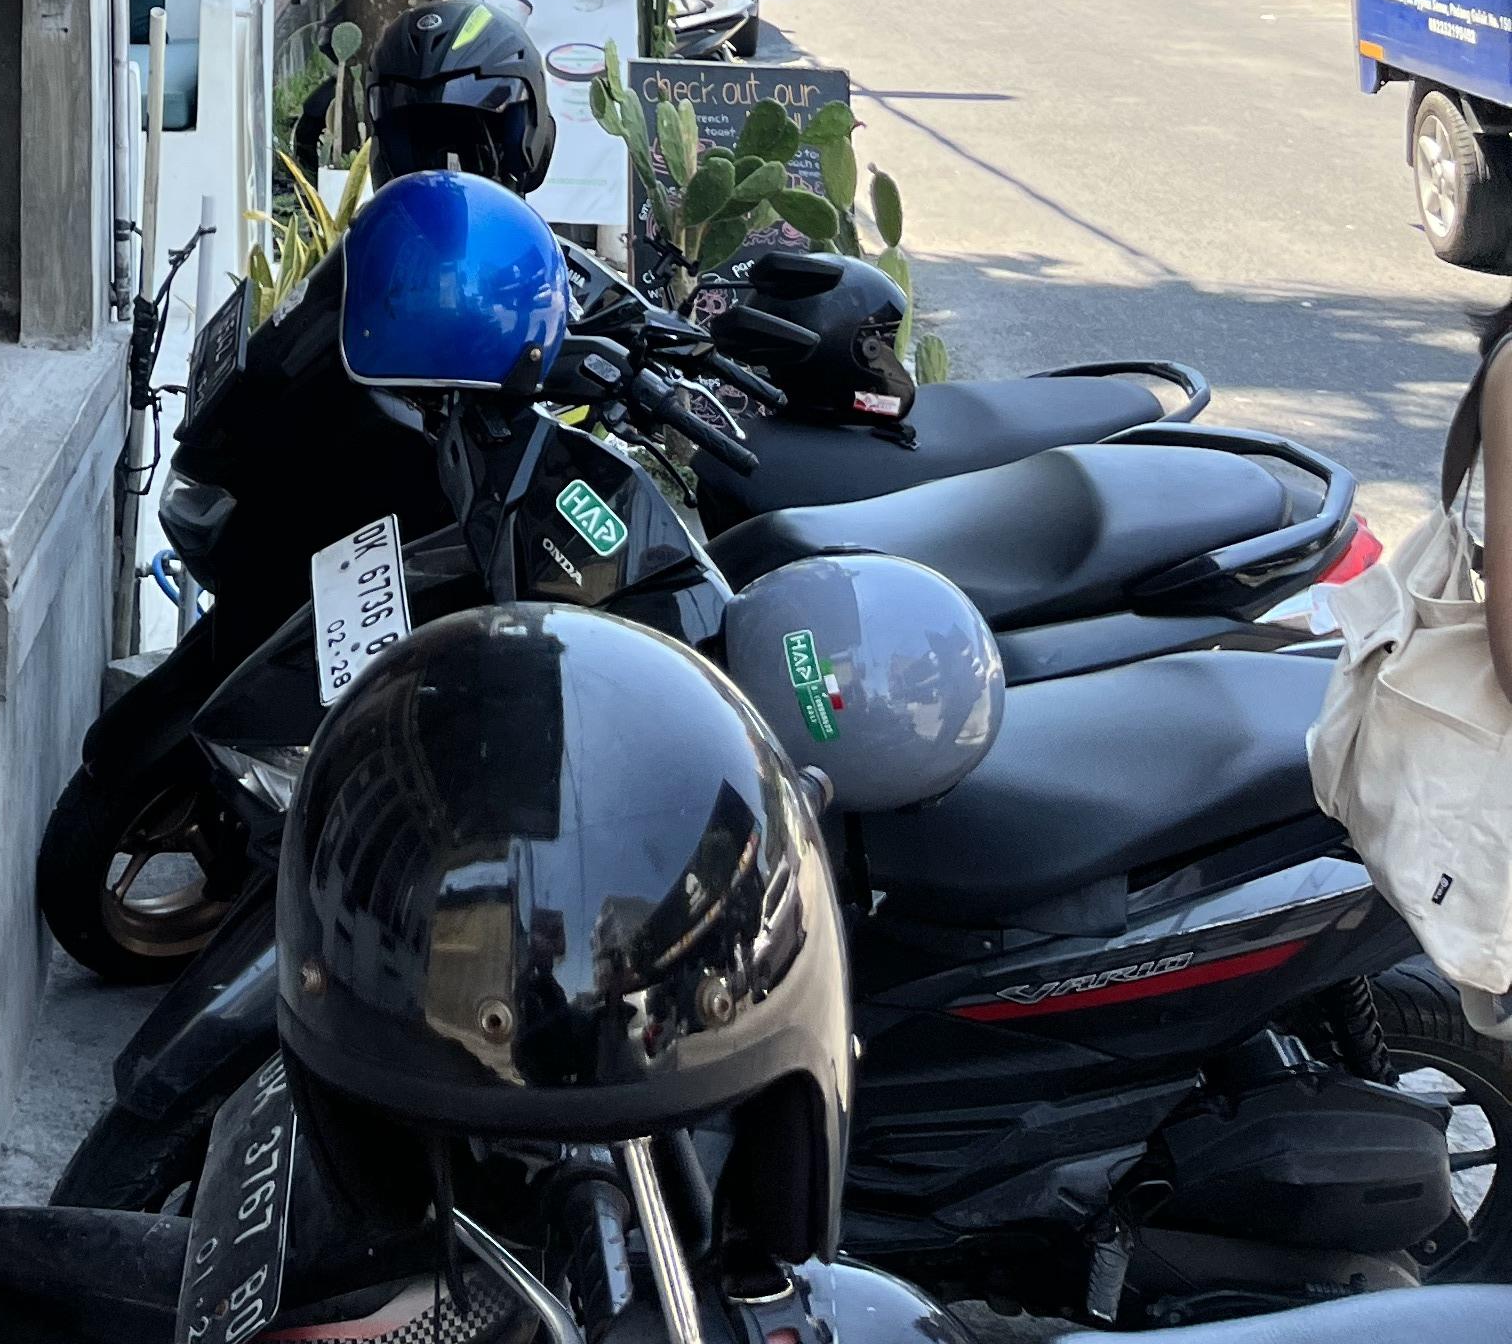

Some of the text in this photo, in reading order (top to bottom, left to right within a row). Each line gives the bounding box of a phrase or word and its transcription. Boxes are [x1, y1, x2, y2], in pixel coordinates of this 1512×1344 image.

[643, 70, 821, 107] check out our
[696, 113, 729, 124] rench
[352, 521, 388, 560] DK
[357, 563, 395, 629] 6736
[996, 951, 1194, 1005] VARIO
[234, 1124, 282, 1246] 3767
